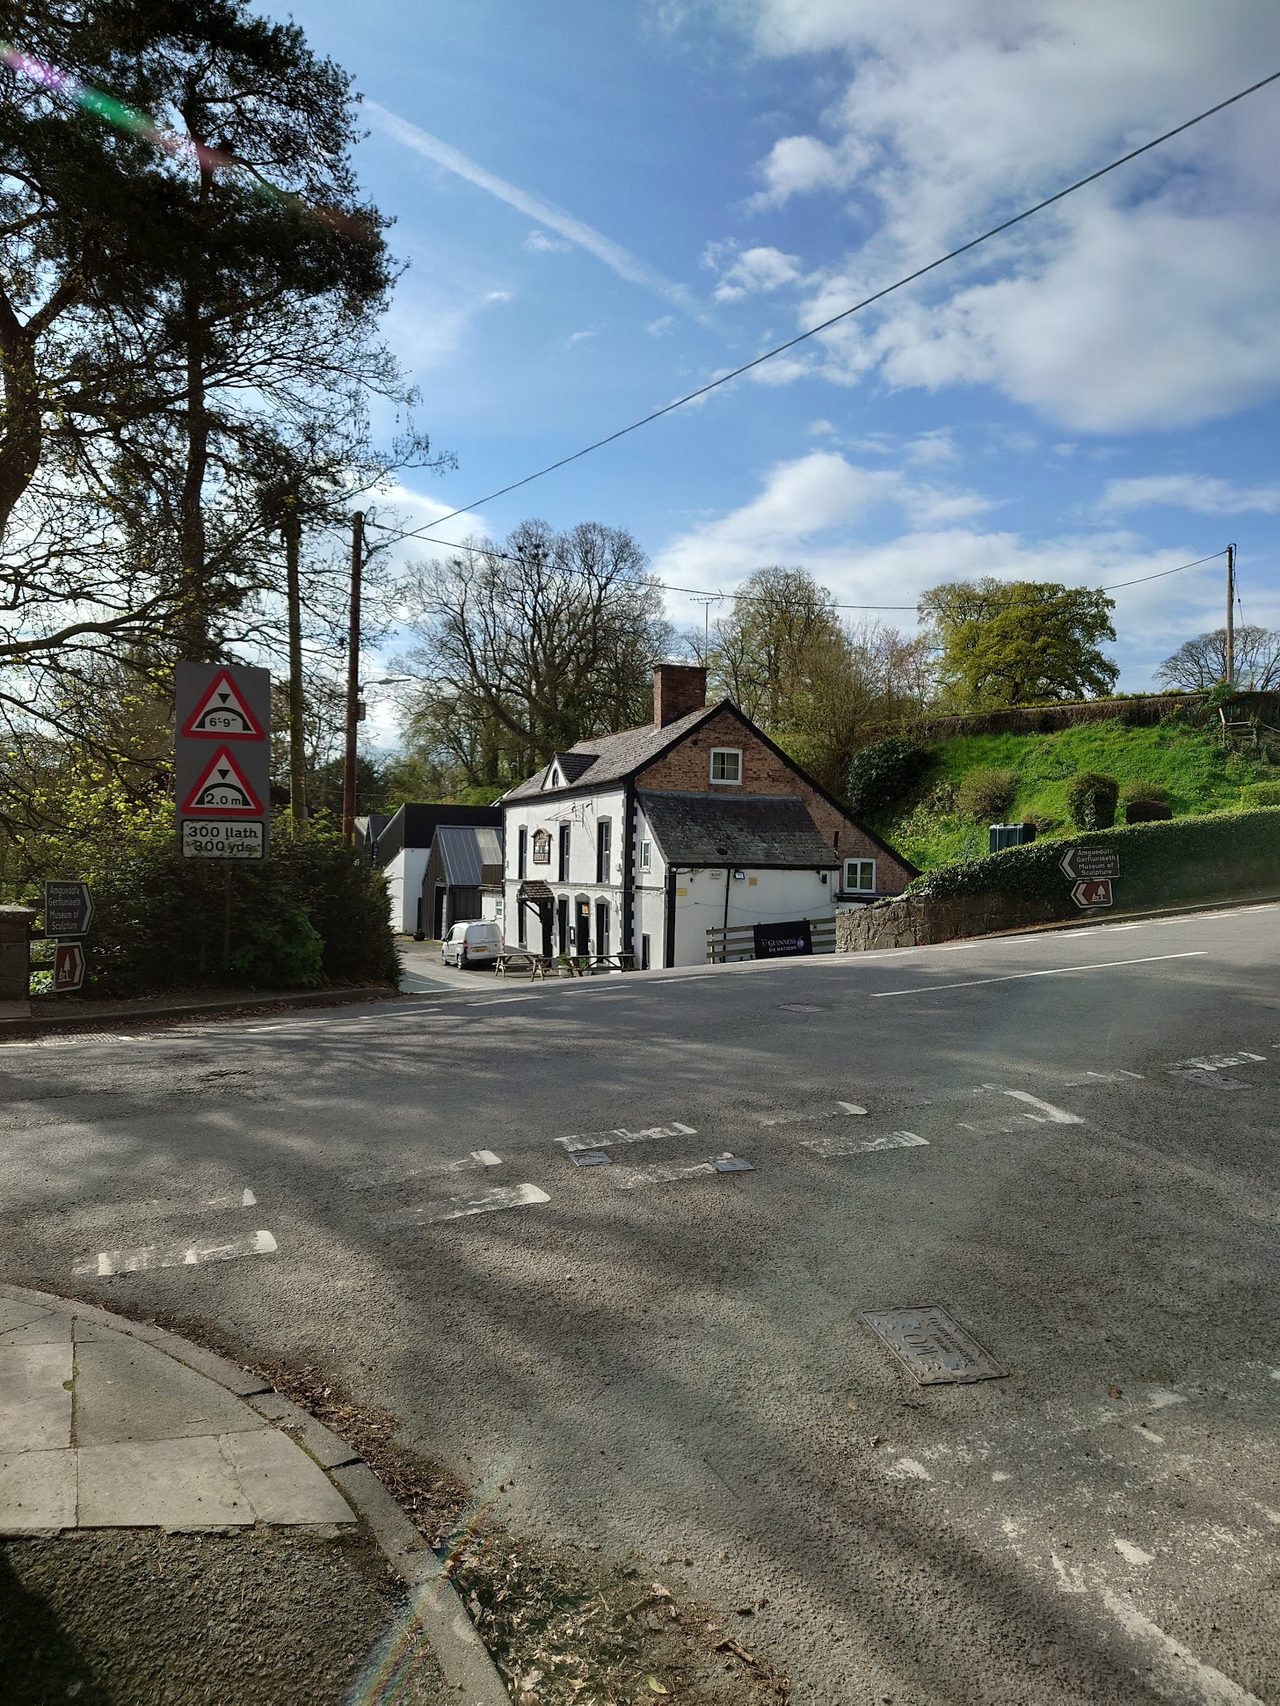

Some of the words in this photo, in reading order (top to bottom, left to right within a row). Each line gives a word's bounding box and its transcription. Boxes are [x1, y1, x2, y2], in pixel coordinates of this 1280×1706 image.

[205, 792, 228, 805] 2.0
[230, 797, 241, 805] m
[188, 826, 220, 838] 300
[225, 827, 257, 838] llath
[194, 840, 225, 852] 300
[1081, 869, 1113, 877] Sculpture
[49, 910, 72, 919] Museum
[767, 938, 797, 947] GUINNESS
